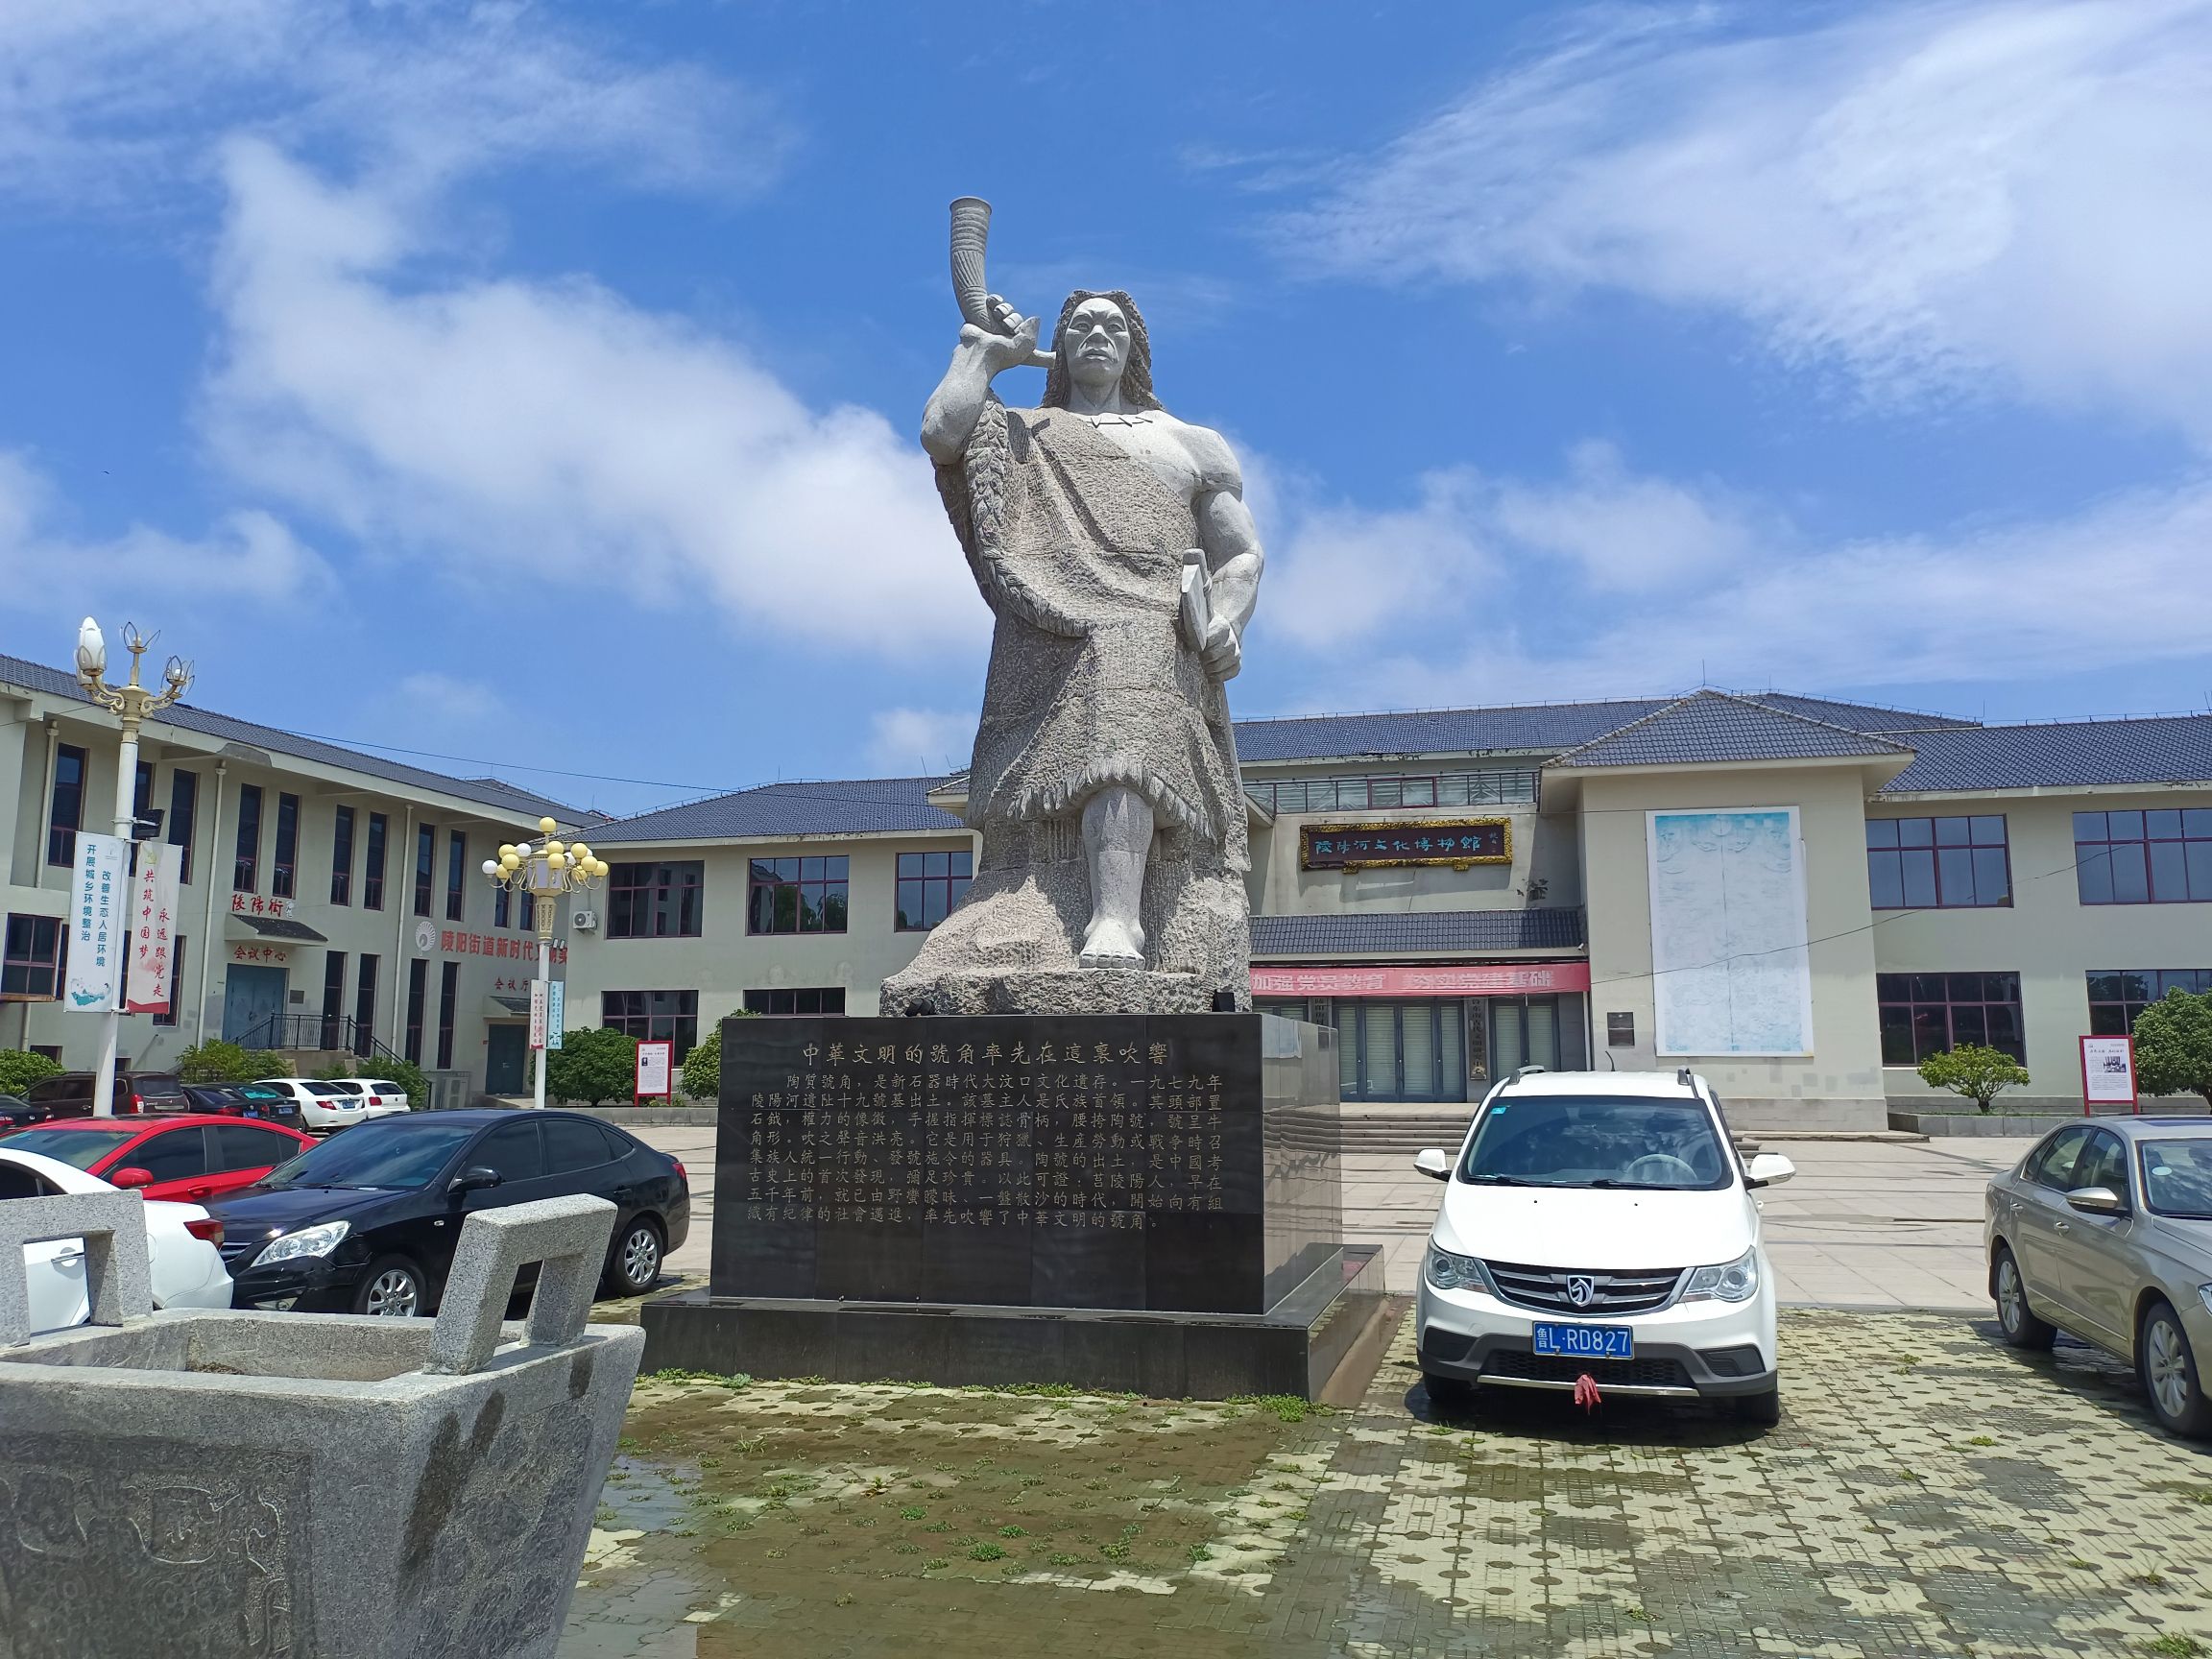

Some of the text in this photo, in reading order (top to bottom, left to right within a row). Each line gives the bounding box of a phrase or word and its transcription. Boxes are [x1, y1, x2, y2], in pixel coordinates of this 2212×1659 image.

[81, 844, 97, 941] 开展城乡环境整治
[96, 871, 111, 967] 改善生态人居环境
[139, 868, 156, 960] 共筑中国梦
[153, 907, 170, 998] 永远跟党走
[233, 945, 286, 963] 会议中心
[441, 929, 568, 965] 陵阳街道新时代明实
[1252, 973, 1384, 991] 加强党员教育
[803, 1041, 1168, 1066] 中華文明的號角率先在這裏吹響
[1536, 1327, 1629, 1353] 鲁L·RD827
